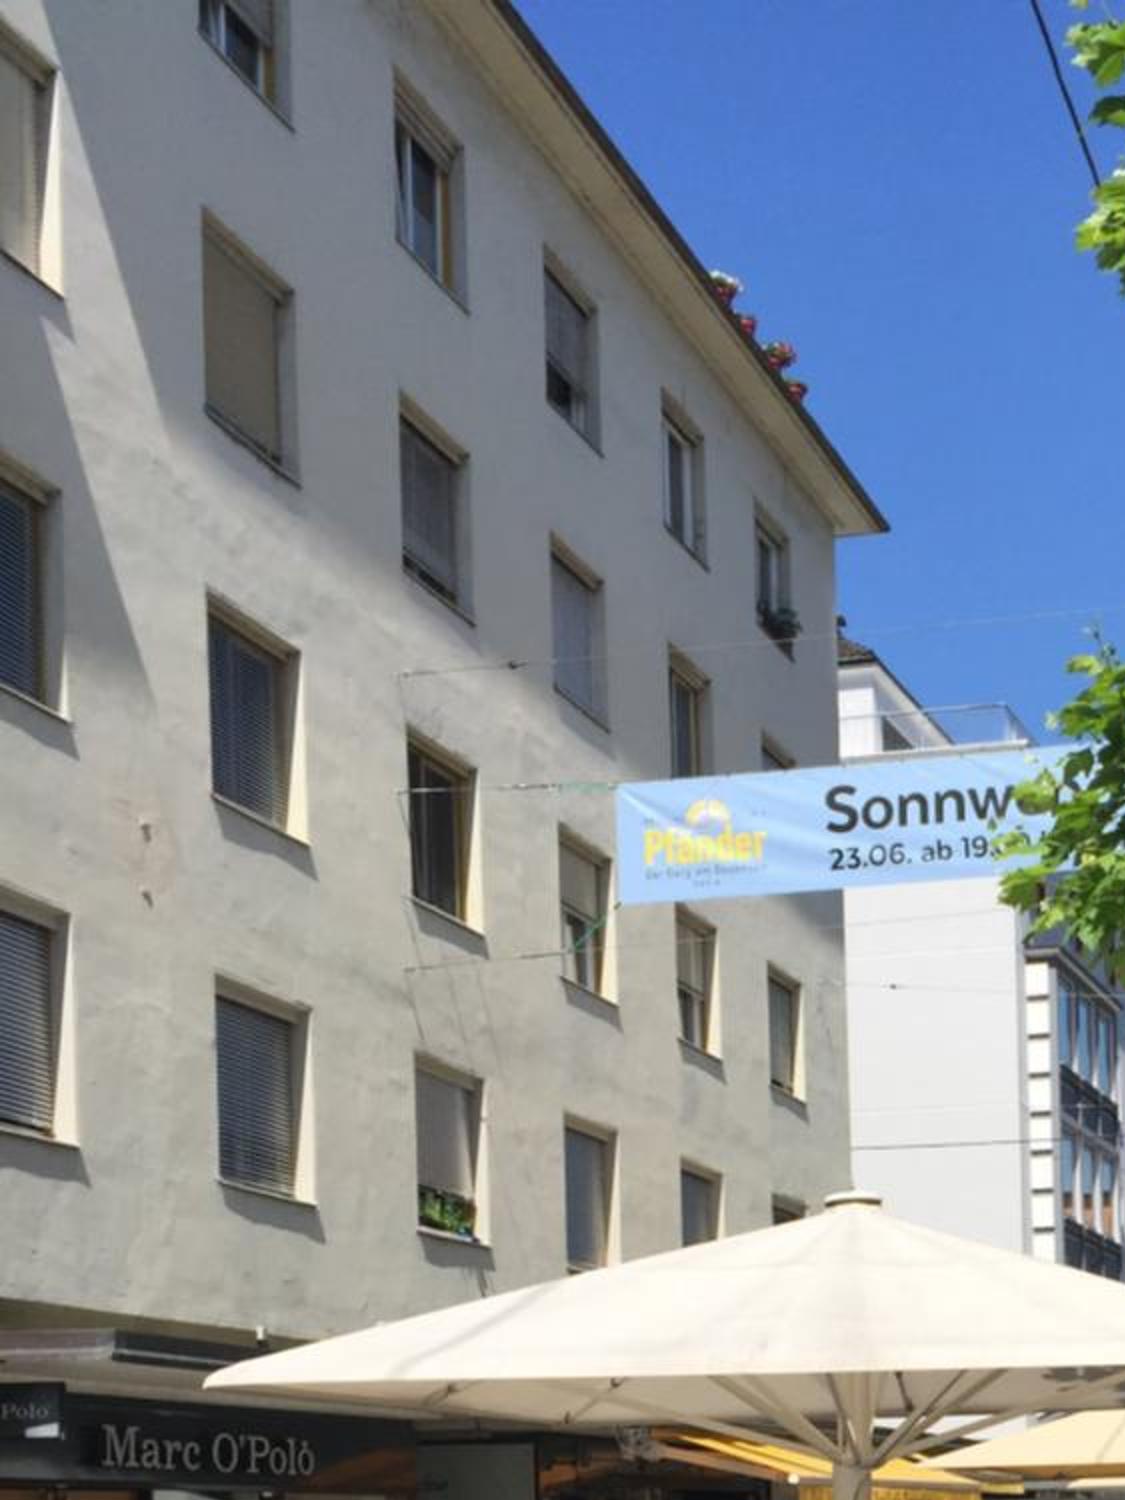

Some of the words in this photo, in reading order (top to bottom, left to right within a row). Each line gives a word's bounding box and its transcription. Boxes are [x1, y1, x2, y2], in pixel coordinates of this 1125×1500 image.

[829, 843, 913, 871] 23.06.
[921, 839, 953, 863] ab
[101, 1424, 201, 1472] Marc
